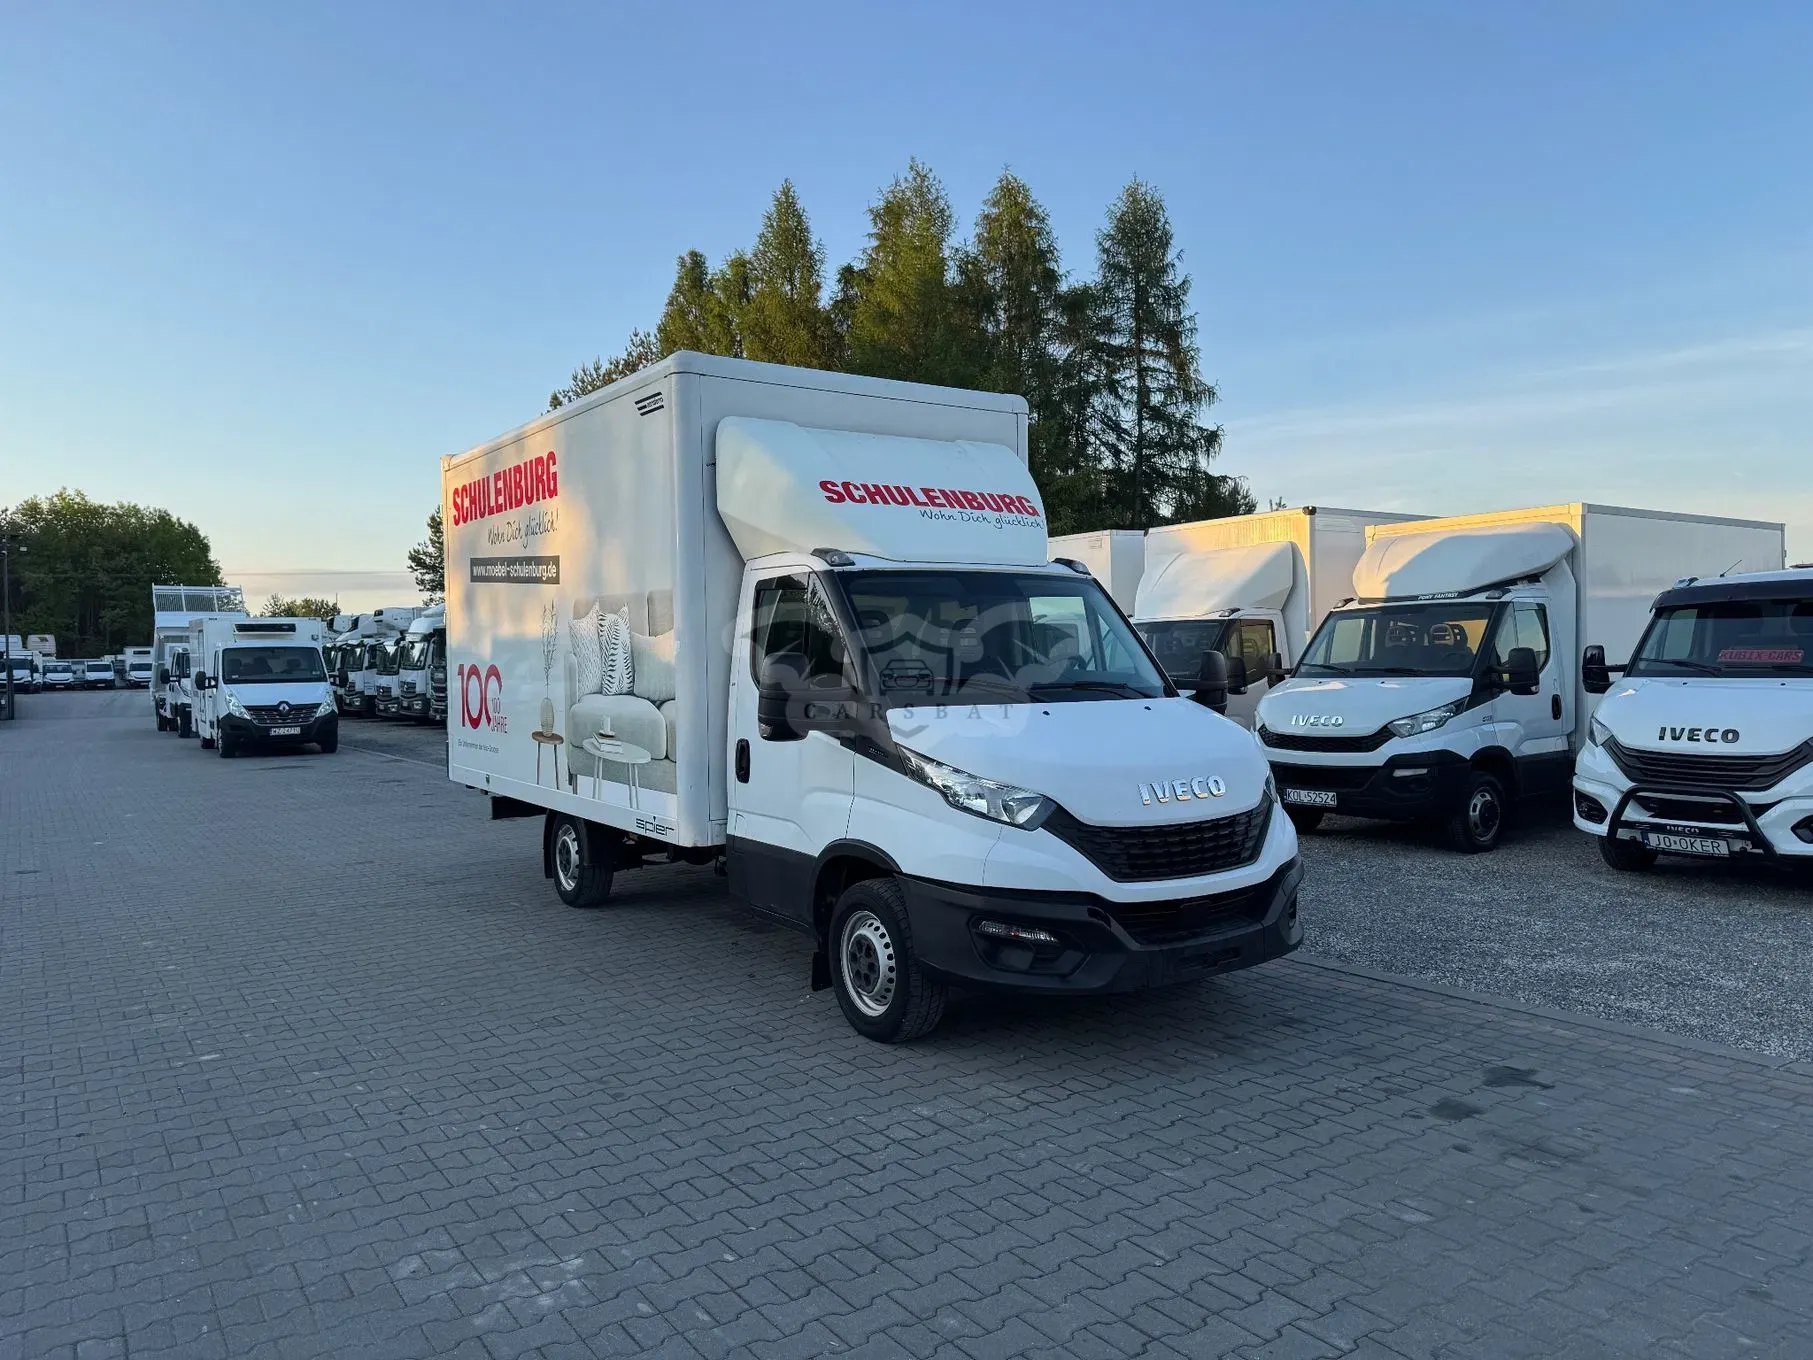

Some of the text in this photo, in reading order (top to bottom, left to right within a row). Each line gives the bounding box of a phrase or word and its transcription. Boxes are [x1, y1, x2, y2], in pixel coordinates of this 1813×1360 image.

[453, 451, 558, 526] SCHULENBURG
[818, 480, 1041, 517] SCHULENBURG
[919, 508, 957, 521] Wohn
[958, 511, 991, 524] Dich
[472, 561, 557, 581] www.moebel-schulenburg.de
[1290, 714, 1344, 728] IVECO
[1658, 726, 1740, 744] IVECO
[1138, 775, 1226, 806] IVECO
[1306, 792, 1336, 804] 52524
[636, 815, 675, 837] spier
